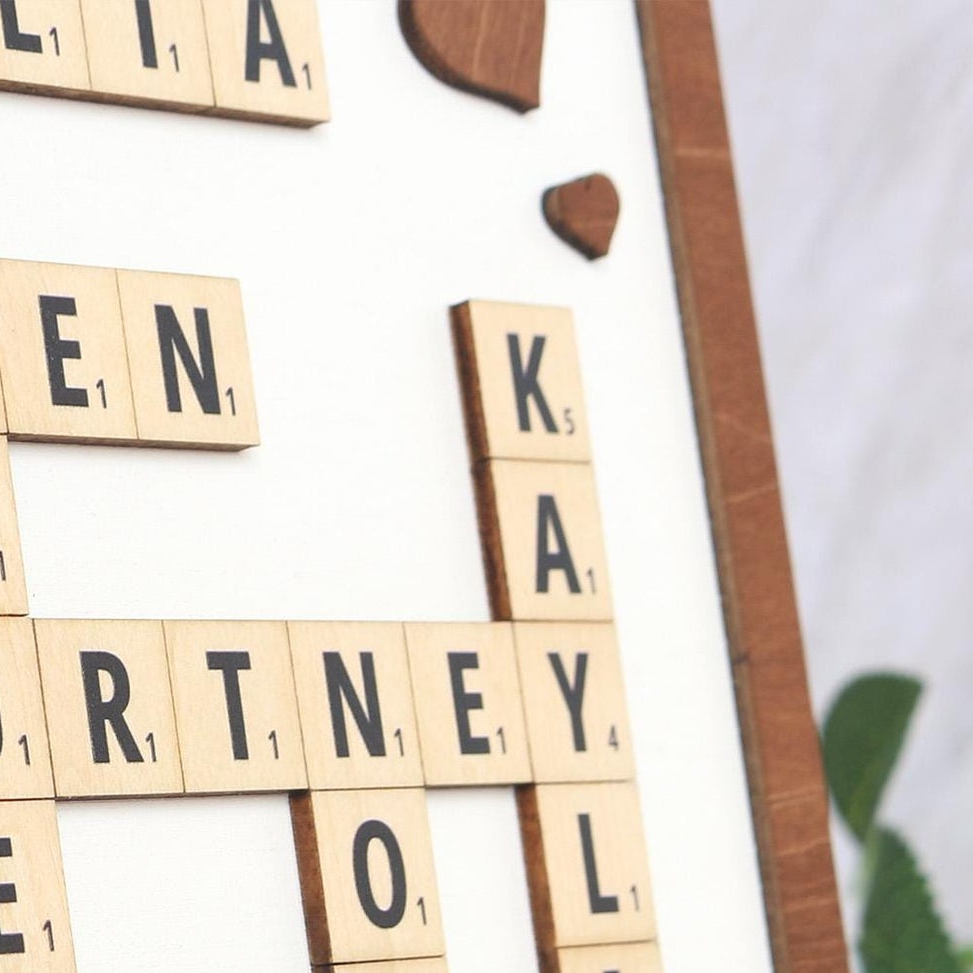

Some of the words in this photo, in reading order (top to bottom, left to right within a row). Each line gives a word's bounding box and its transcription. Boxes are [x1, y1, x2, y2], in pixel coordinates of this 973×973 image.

[49, 26, 60, 57] 1
[169, 43, 180, 73] 1
[302, 63, 312, 90] 1
[95, 378, 108, 409] 1
[225, 386, 236, 417] 1
[563, 408, 576, 436] 5
[586, 568, 596, 594] 1
[18, 734, 31, 766] 1
[145, 732, 157, 763] 1
[268, 730, 280, 760] 1
[393, 728, 405, 757] 1
[496, 726, 507, 754] 1
[607, 725, 619, 751] 4
[416, 896, 427, 926] 1
[630, 885, 639, 911] 1
[42, 919, 55, 952] 1
